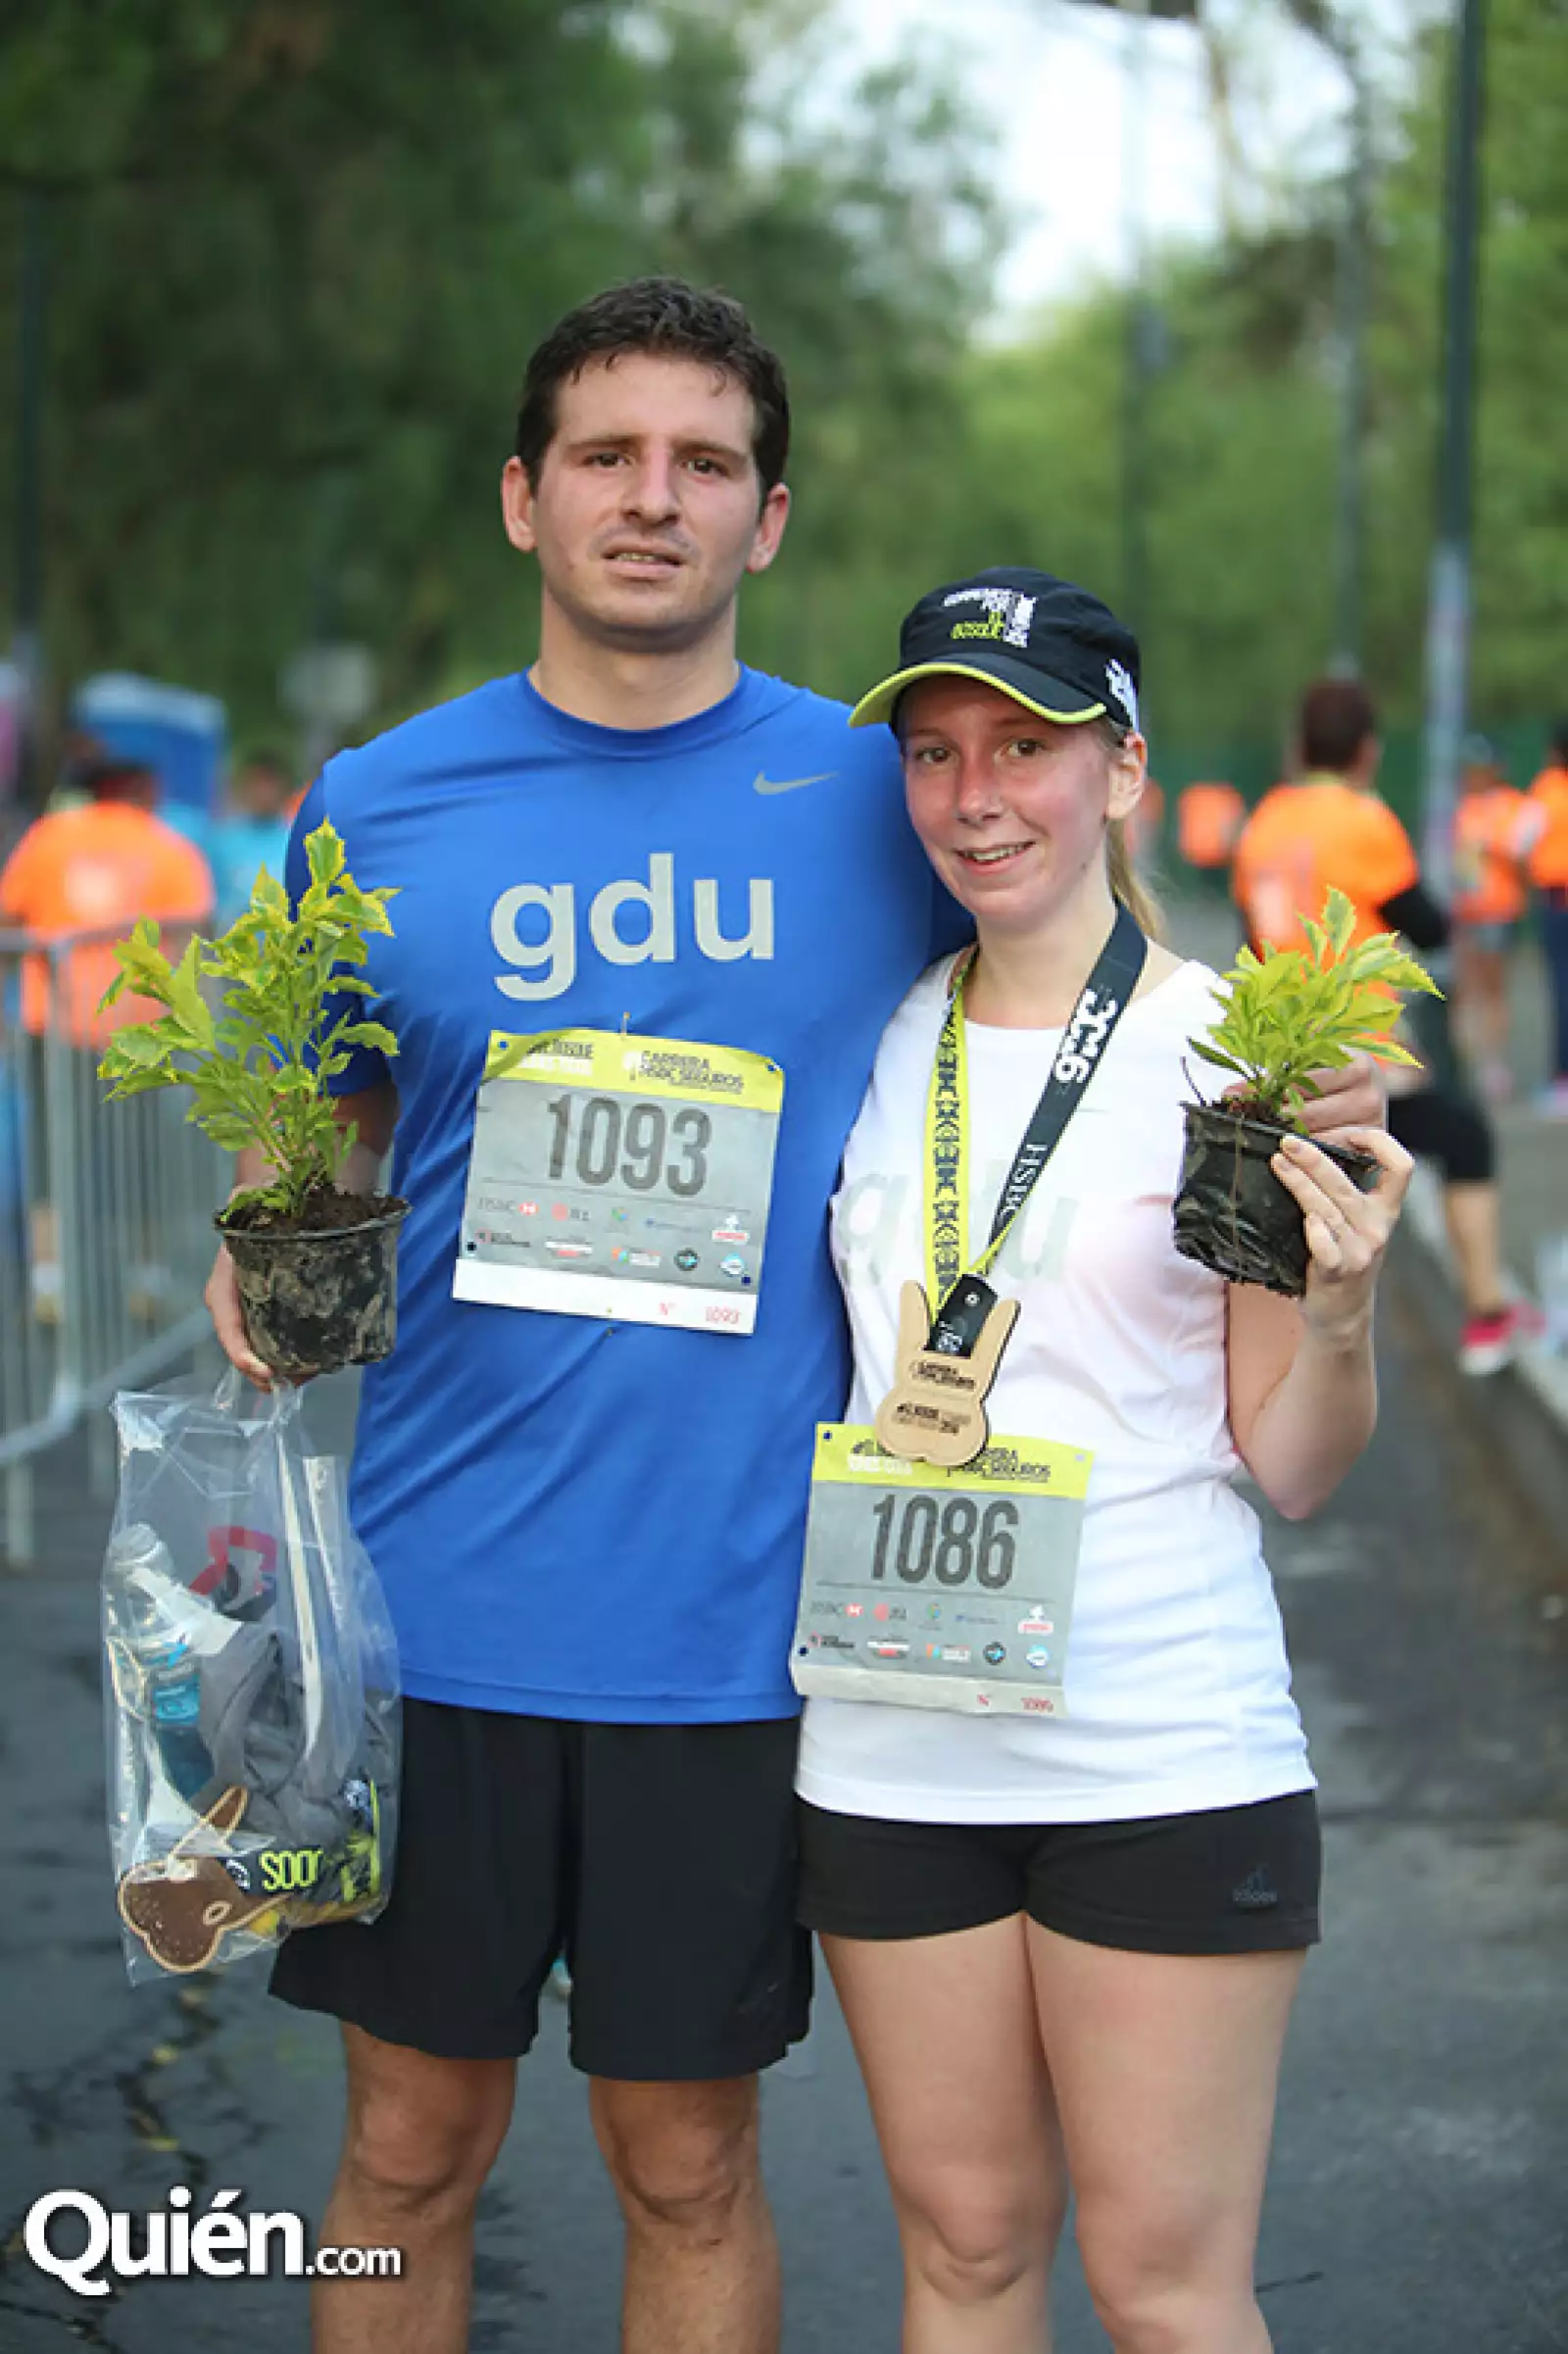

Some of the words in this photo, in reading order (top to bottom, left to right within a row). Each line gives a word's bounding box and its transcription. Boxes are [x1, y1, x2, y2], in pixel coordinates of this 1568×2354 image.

[490, 853, 774, 1001] gdu
[547, 1094, 713, 1197] 1093
[871, 1494, 1019, 1589] 1086
